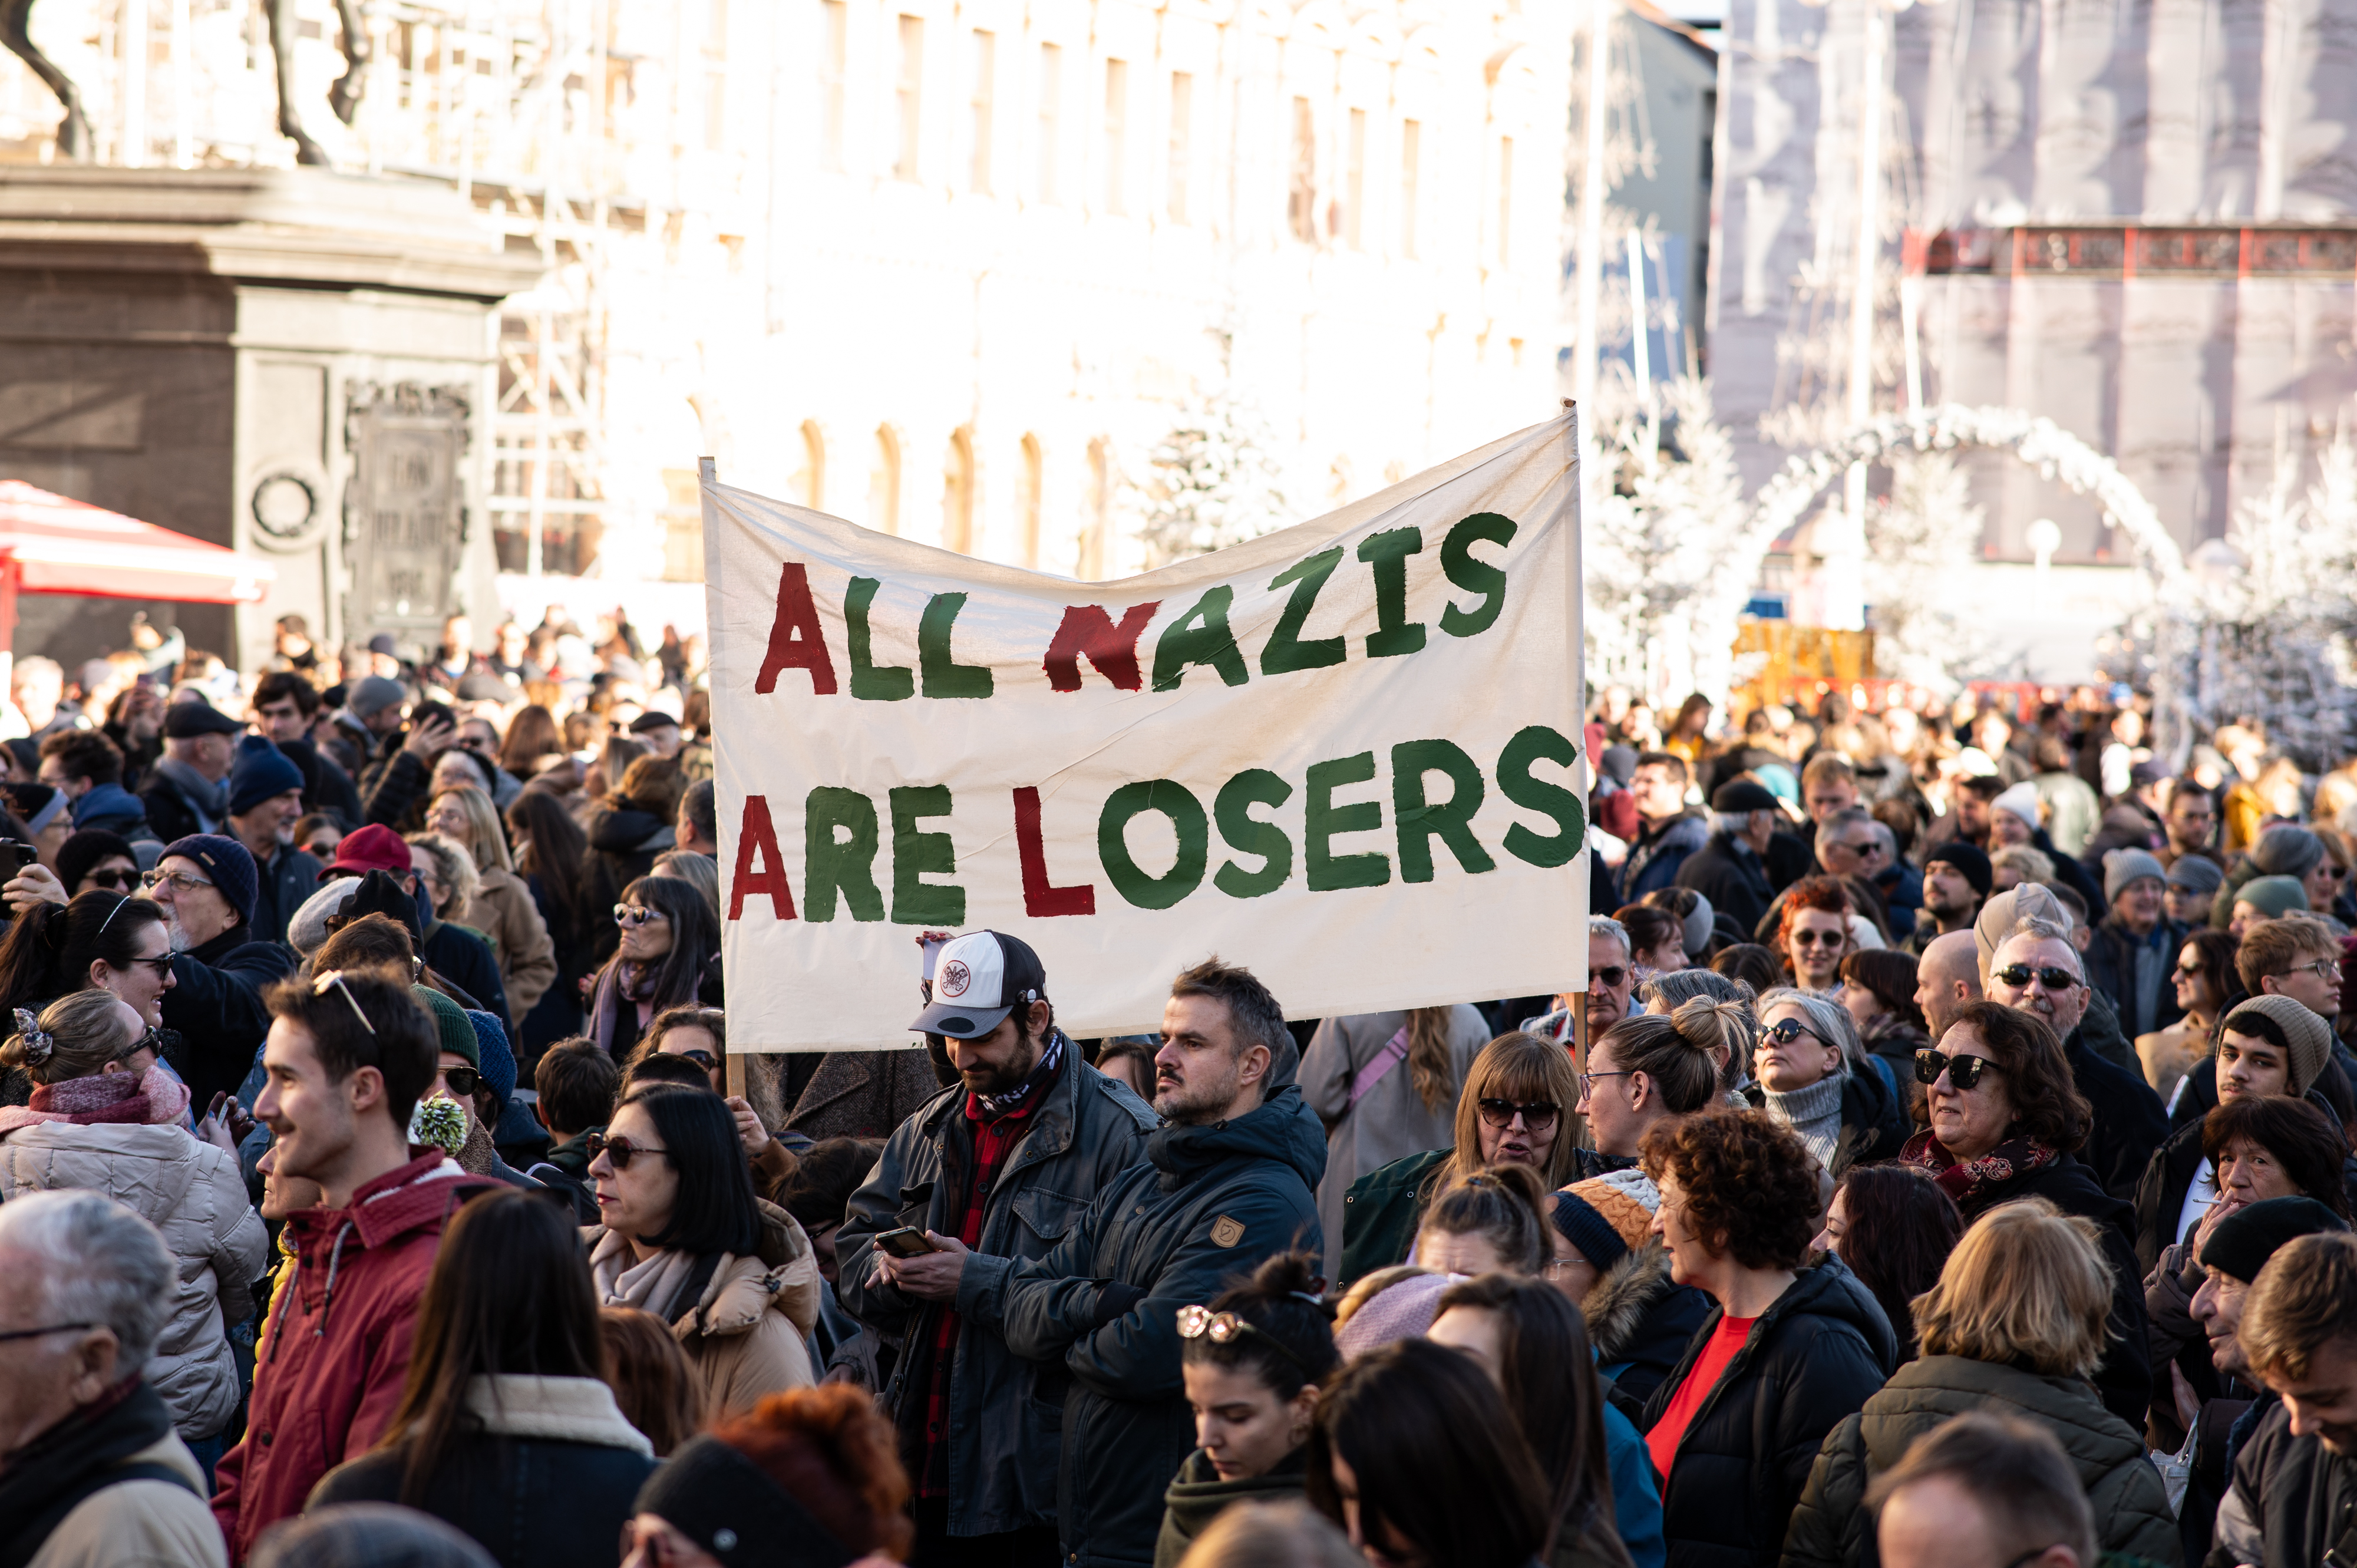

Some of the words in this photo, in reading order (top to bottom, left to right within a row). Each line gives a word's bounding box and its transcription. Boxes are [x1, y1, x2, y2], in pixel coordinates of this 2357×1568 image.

[755, 562, 994, 701] ALL
[1044, 512, 1518, 692] NAZIS
[728, 785, 966, 926] ARE
[1013, 725, 1585, 917] LOSERS
